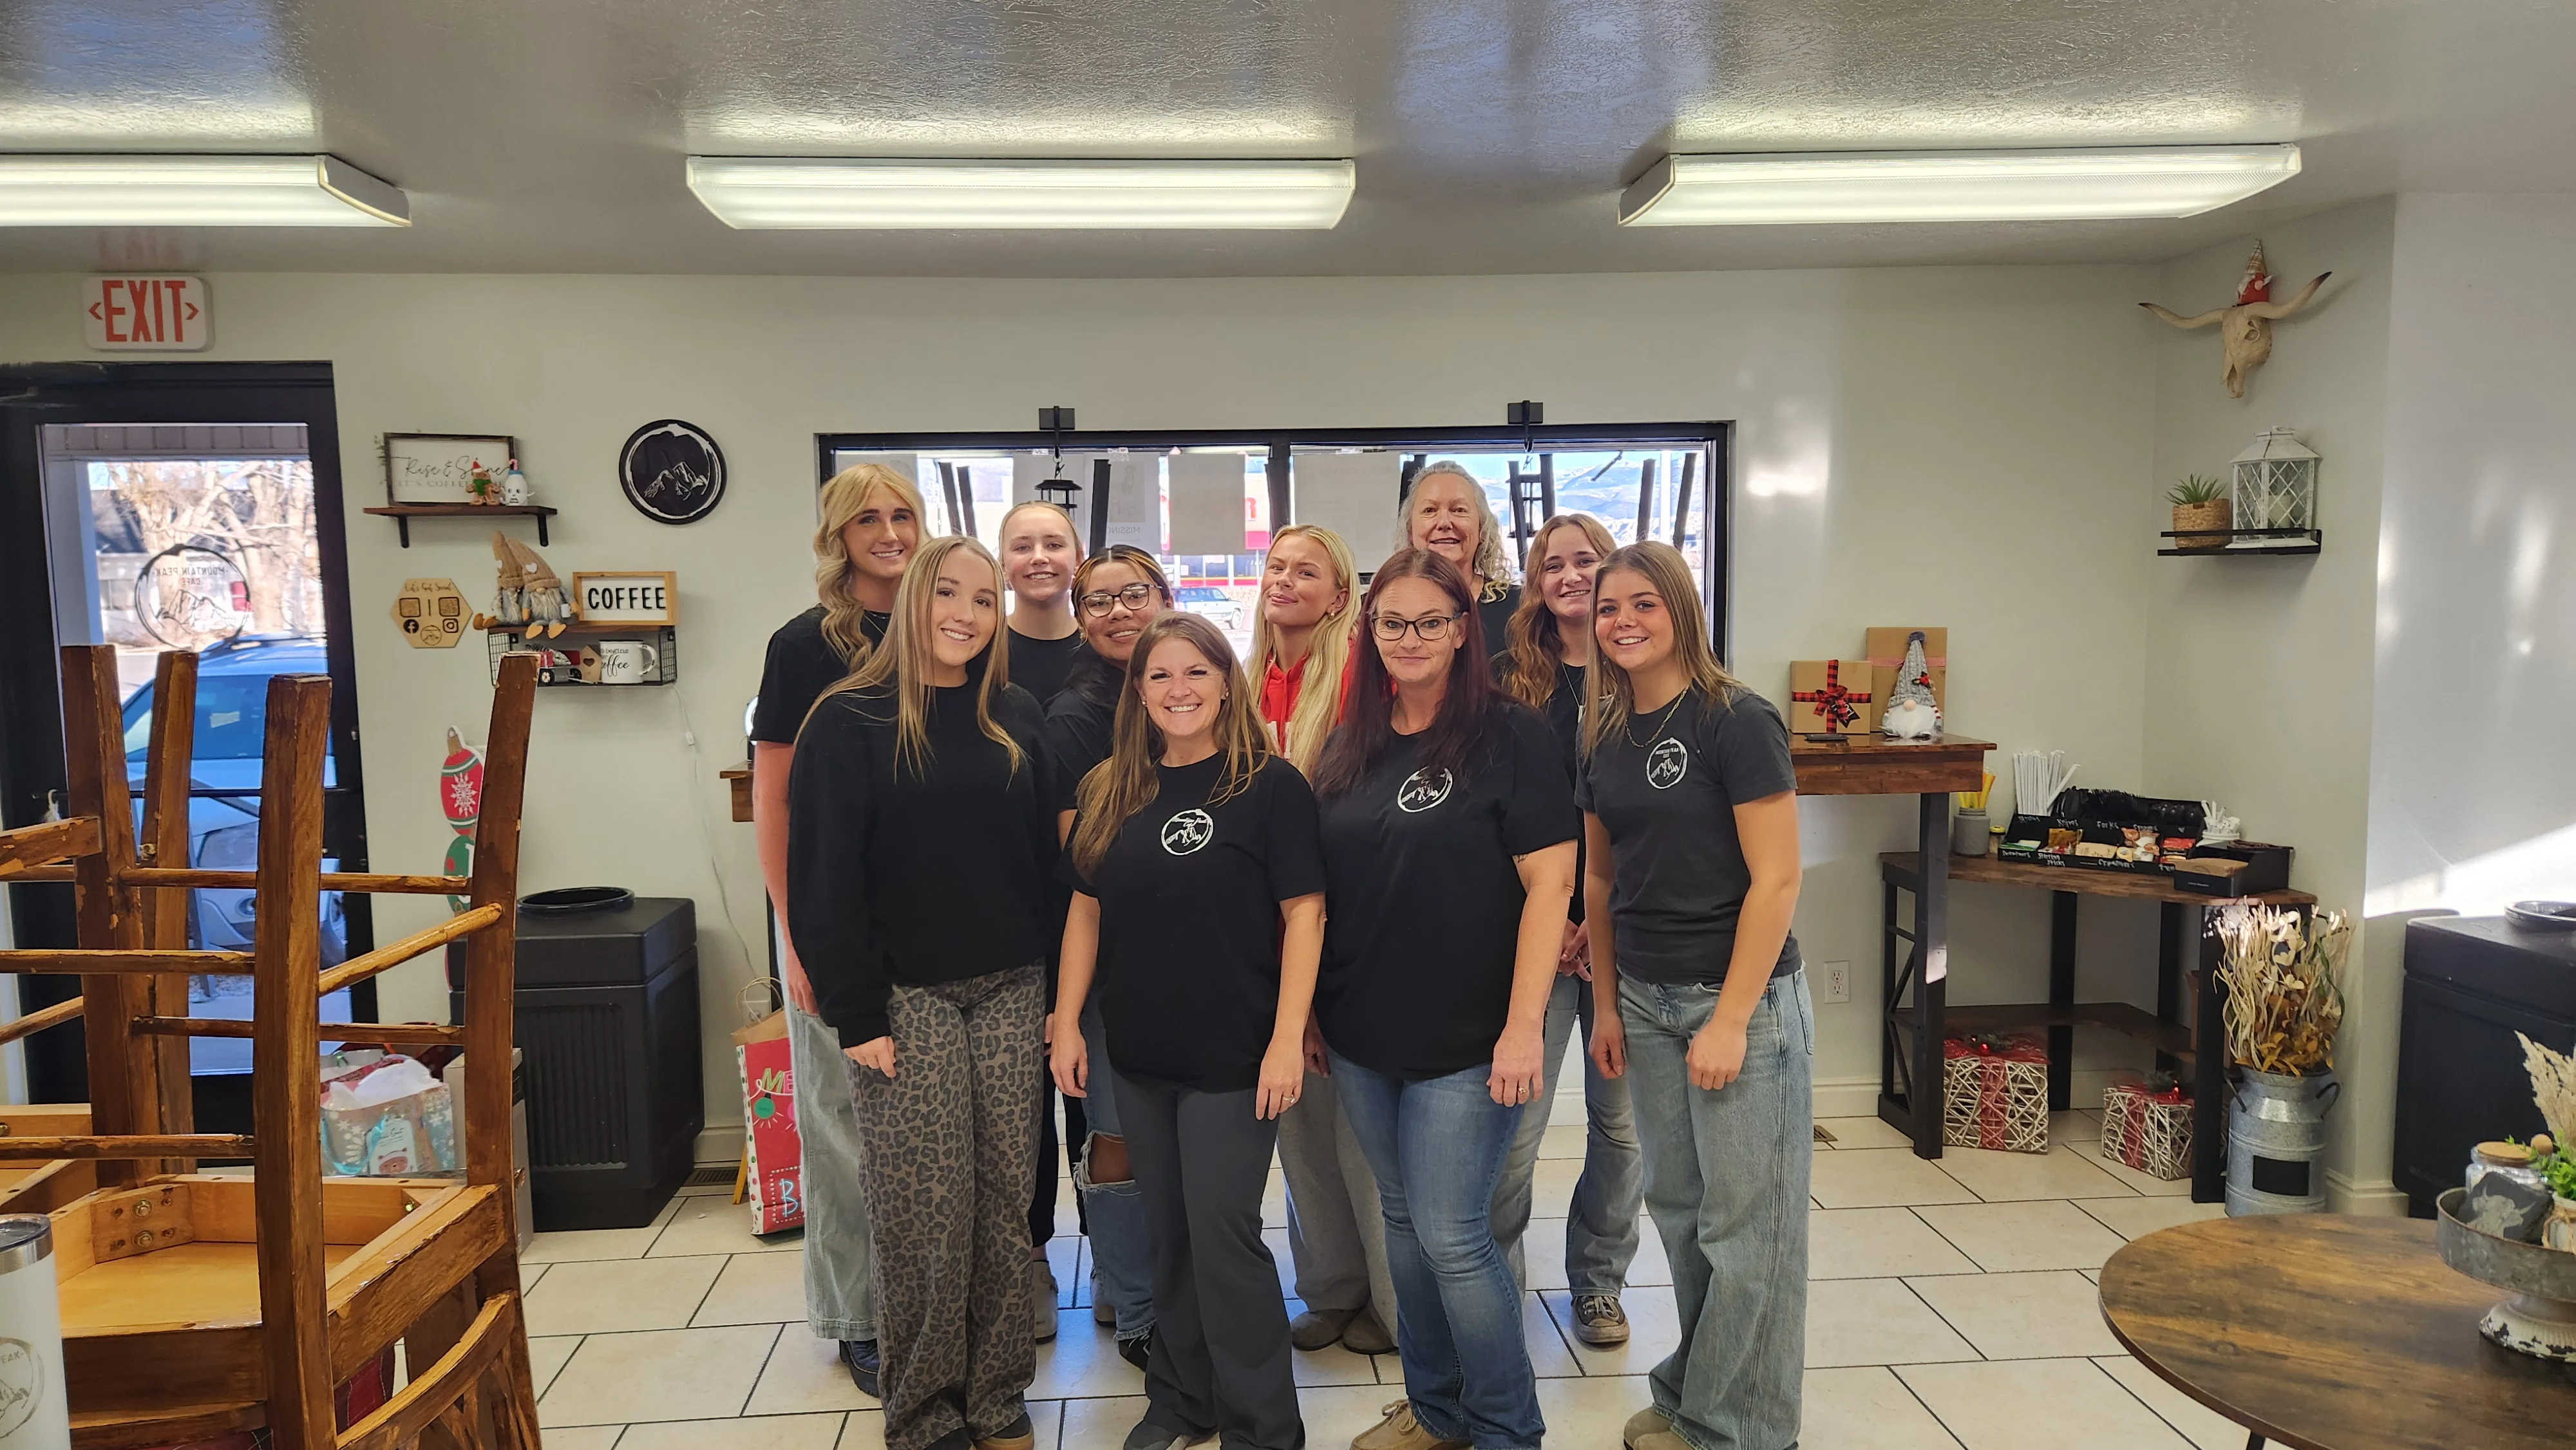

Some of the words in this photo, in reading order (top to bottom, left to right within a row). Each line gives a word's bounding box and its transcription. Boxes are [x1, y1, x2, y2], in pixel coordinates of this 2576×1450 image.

[102, 280, 187, 343] EXIT
[587, 587, 667, 609] COFFEE
[761, 1068, 793, 1094] ME
